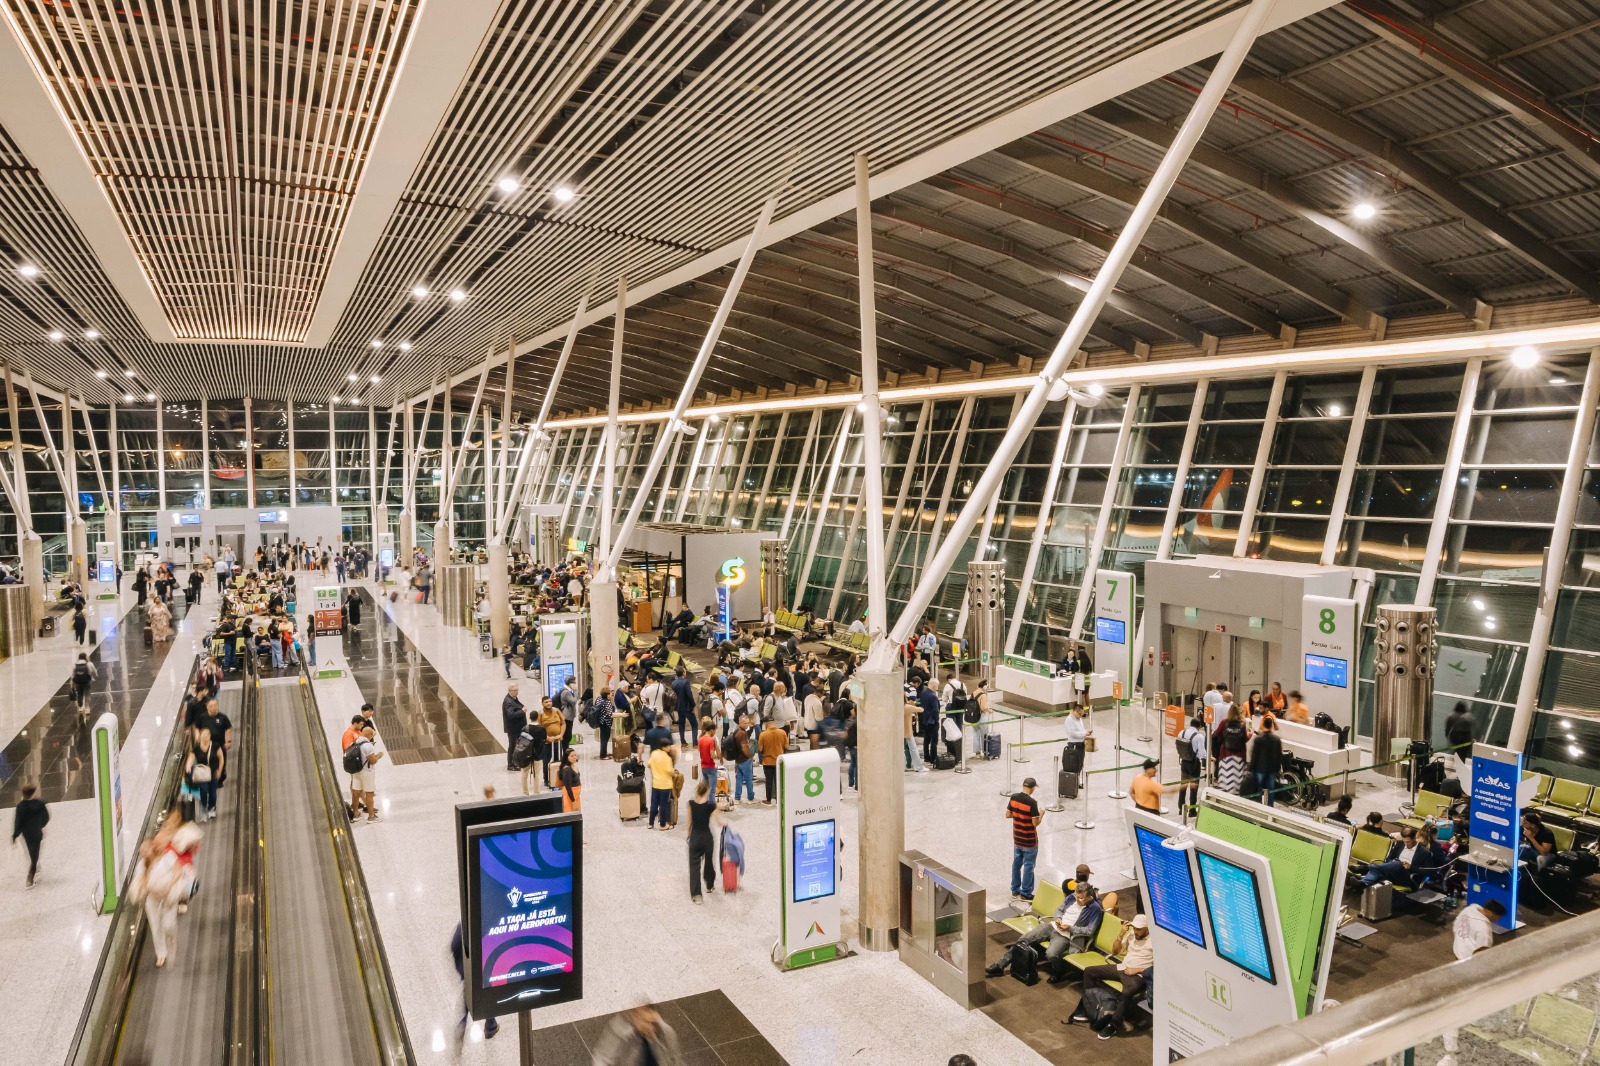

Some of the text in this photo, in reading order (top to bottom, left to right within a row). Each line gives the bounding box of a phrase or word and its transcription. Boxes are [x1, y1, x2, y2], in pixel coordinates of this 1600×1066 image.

[172, 512, 180, 525] 1
[279, 510, 288, 522] 2
[102, 546, 109, 554] 3
[1106, 579, 1118, 601] 7
[1319, 608, 1336, 634] 8
[553, 631, 567, 650] 7
[803, 766, 825, 798] 8
[1474, 794, 1500, 805] completa
[1479, 789, 1495, 797] conta
[1495, 793, 1513, 802] digital
[795, 807, 816, 816] Portão
[1480, 802, 1506, 812] empresas
[499, 905, 557, 926] A TAÇA JÁ ESTÁ
[488, 925, 508, 936] AQUI
[520, 914, 567, 931] AEROPORTO!
